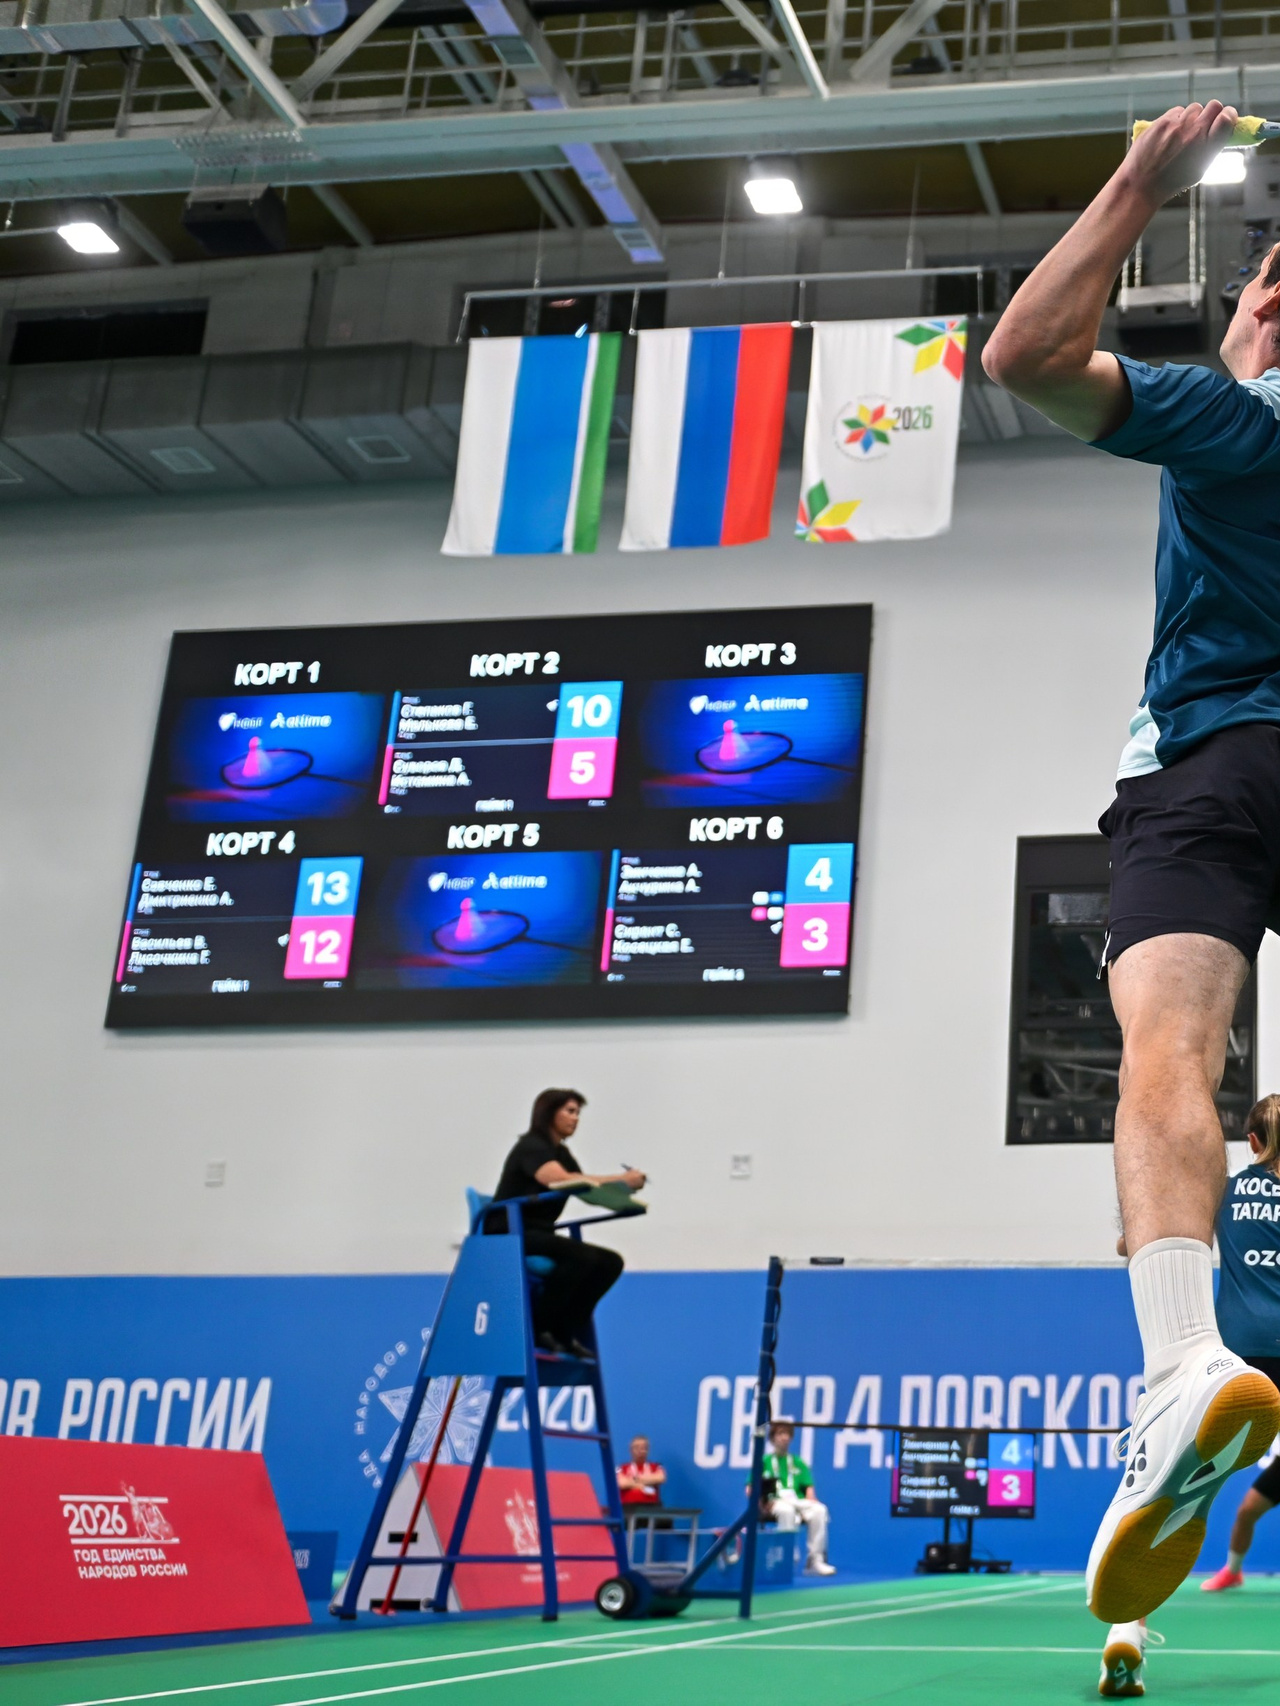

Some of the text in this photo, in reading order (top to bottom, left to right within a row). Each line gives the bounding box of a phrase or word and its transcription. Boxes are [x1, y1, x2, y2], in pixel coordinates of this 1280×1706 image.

[892, 405, 933, 431] 2026
[470, 651, 560, 677] КОРТ 2
[705, 642, 796, 668] КОРТ 3
[234, 661, 321, 686] КОРТ 1
[567, 694, 613, 728] 10
[569, 751, 596, 784] 5
[447, 823, 540, 849] КОРТ 5
[689, 816, 784, 841] КОРТ 6
[206, 830, 295, 856] КОРТ 4
[804, 857, 833, 892] 4
[307, 871, 350, 906] 13
[299, 930, 341, 964] 12
[802, 917, 829, 952] 3
[474, 1301, 490, 1335] 6
[1001, 1438, 1021, 1465] 4
[1001, 1474, 1021, 1500] 3
[63, 1503, 128, 1536] 2026
[73, 1548, 166, 1563] ГОД ЕДИНСТВА
[78, 1563, 188, 1579] НАРОДОВ РОССИИ
